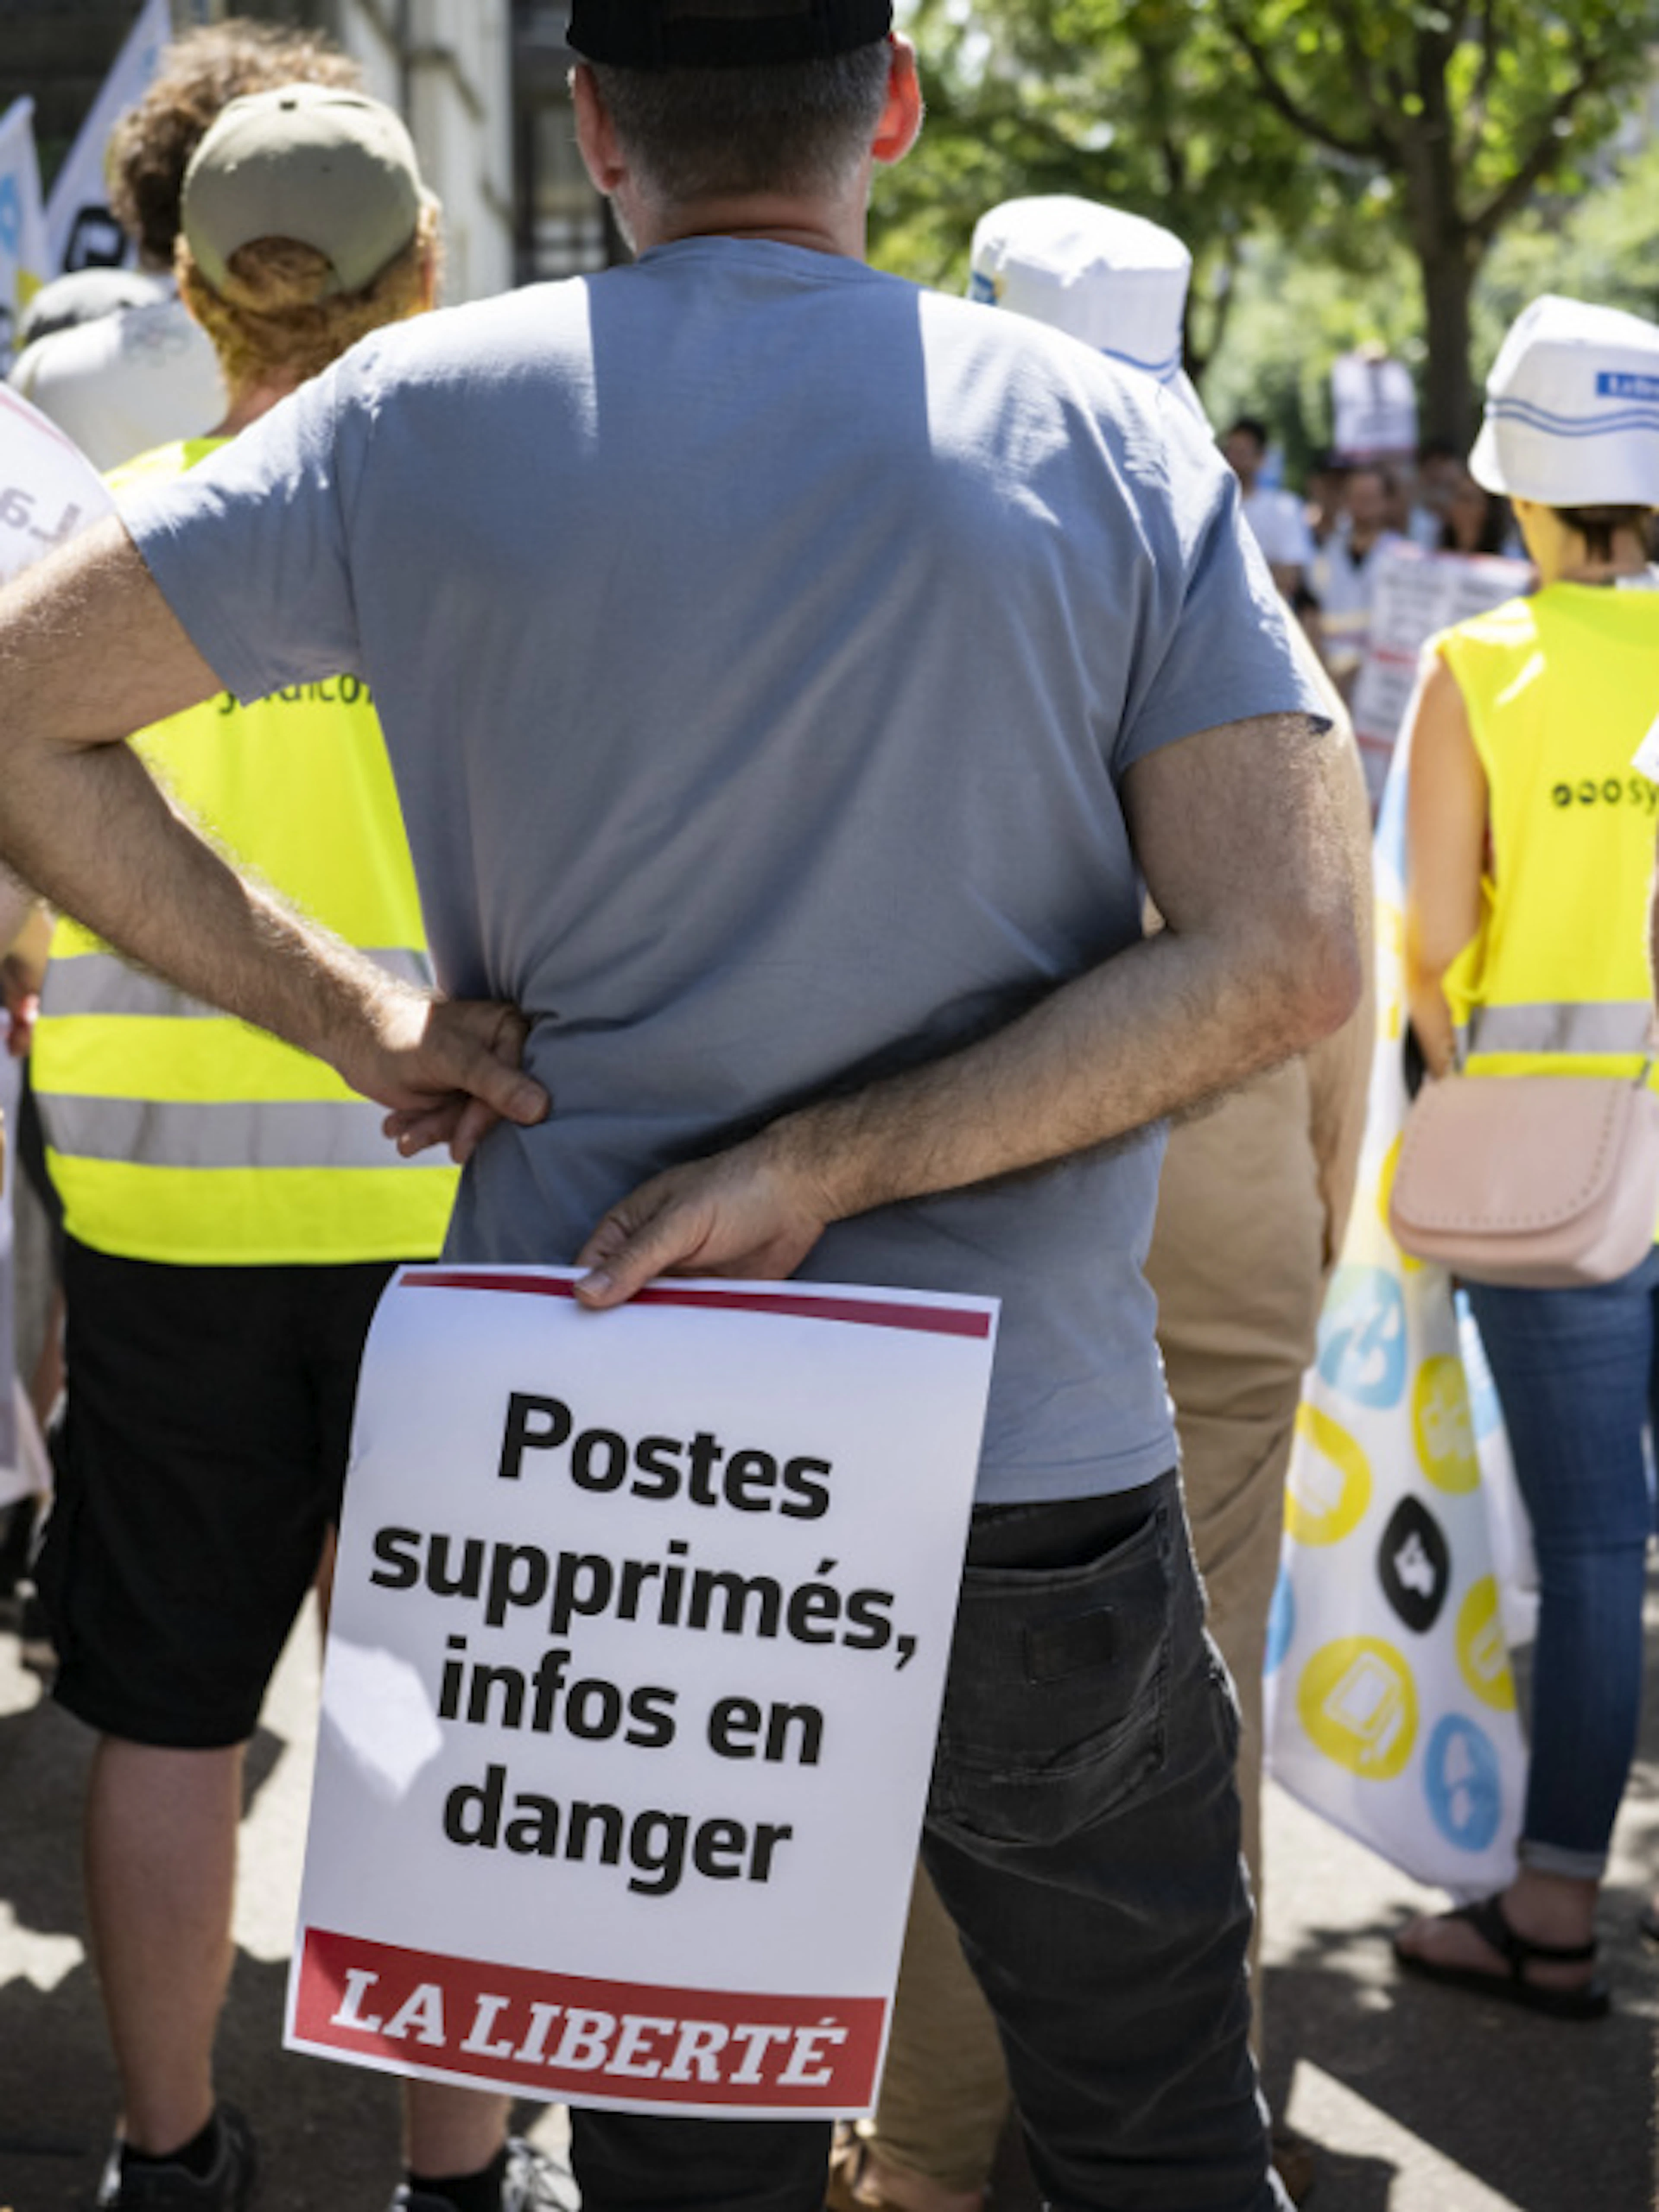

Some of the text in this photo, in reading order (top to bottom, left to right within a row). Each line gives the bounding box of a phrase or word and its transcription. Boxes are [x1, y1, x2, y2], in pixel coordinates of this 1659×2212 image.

[497, 1391, 832, 1520] Postes
[369, 1526, 917, 1671] supprimés,
[437, 1634, 824, 1766] infos en
[442, 1764, 793, 1897] danger
[328, 1968, 848, 2086] LA LIBERTÉ
